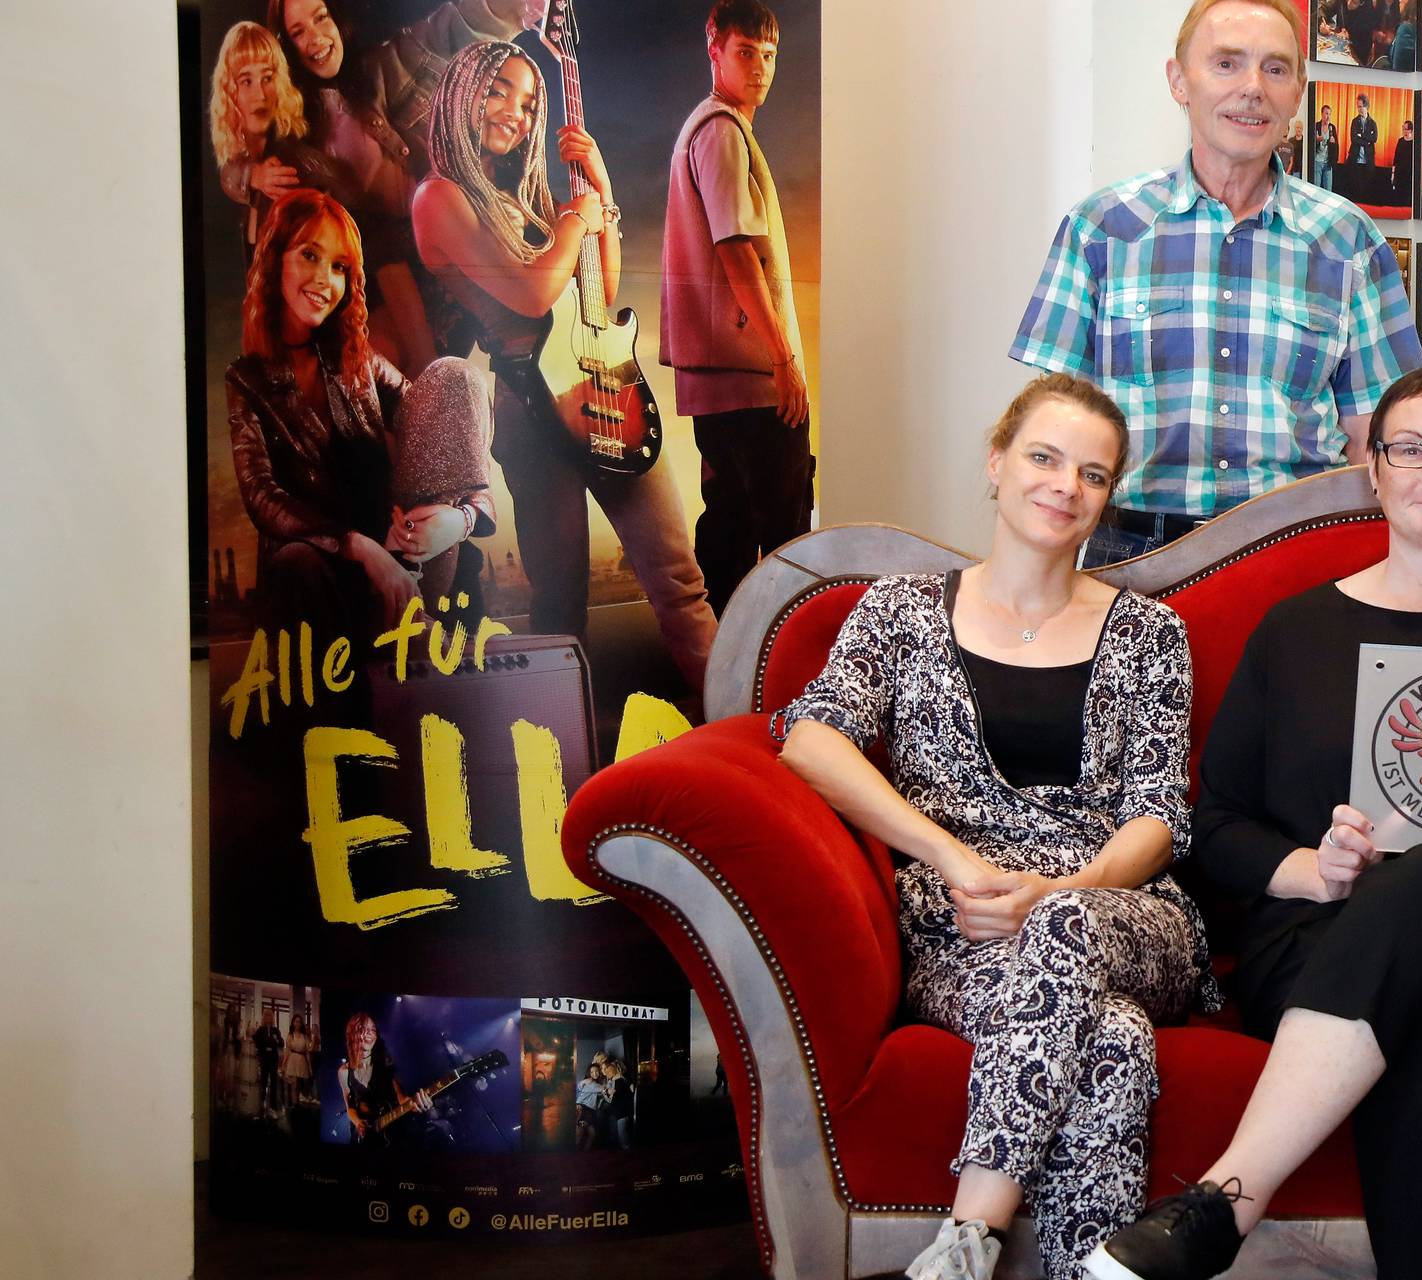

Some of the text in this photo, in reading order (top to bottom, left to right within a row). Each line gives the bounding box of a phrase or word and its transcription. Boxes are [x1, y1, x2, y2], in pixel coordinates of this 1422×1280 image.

[221, 591, 512, 739] Alle für
[1382, 761, 1405, 790] IST
[538, 997, 655, 1020] FOTOAUTOMAT
[491, 1211, 629, 1230] @AlleFuerElla
